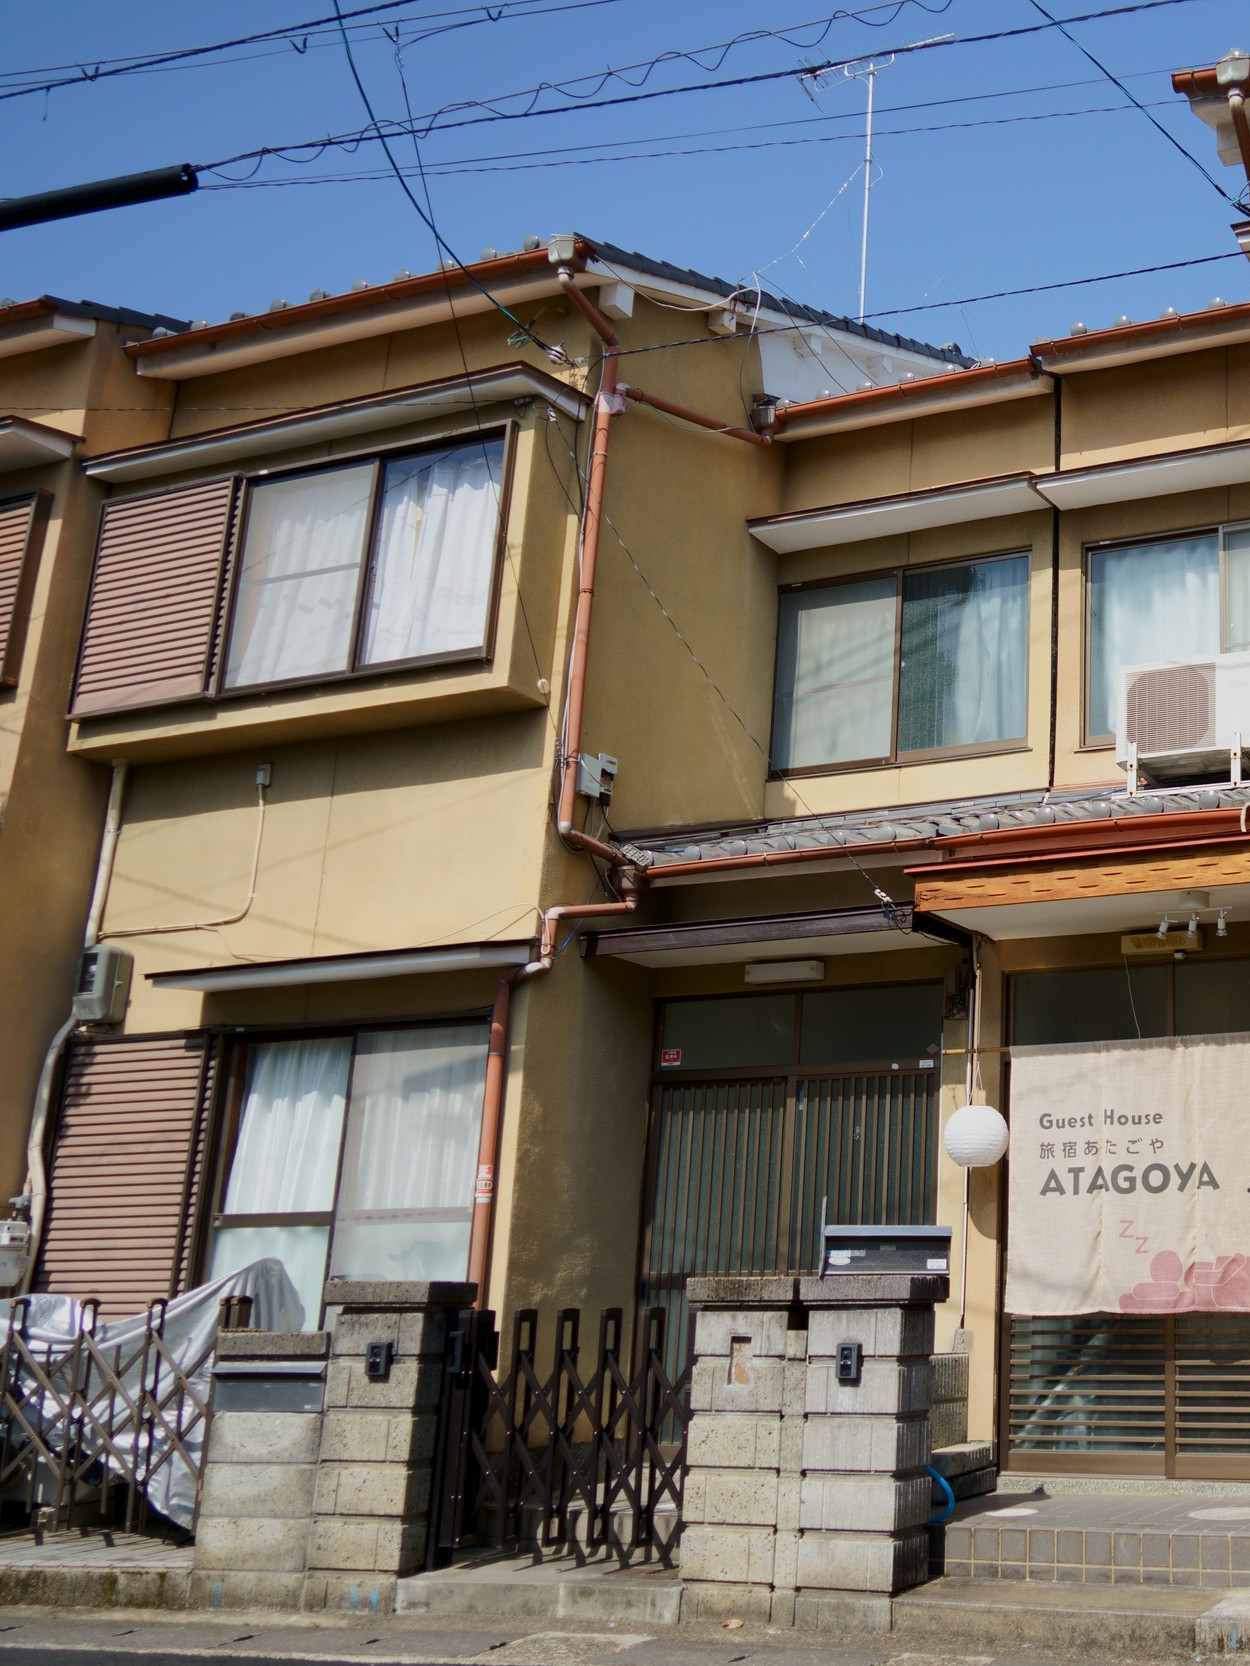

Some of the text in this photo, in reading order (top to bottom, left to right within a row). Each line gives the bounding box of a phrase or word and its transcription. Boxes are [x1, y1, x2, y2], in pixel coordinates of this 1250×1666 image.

[1039, 1109, 1163, 1130] Guest House
[1039, 1138, 1164, 1159] 旅宿あたごや
[1039, 1160, 1221, 1197] ATAGOYA
